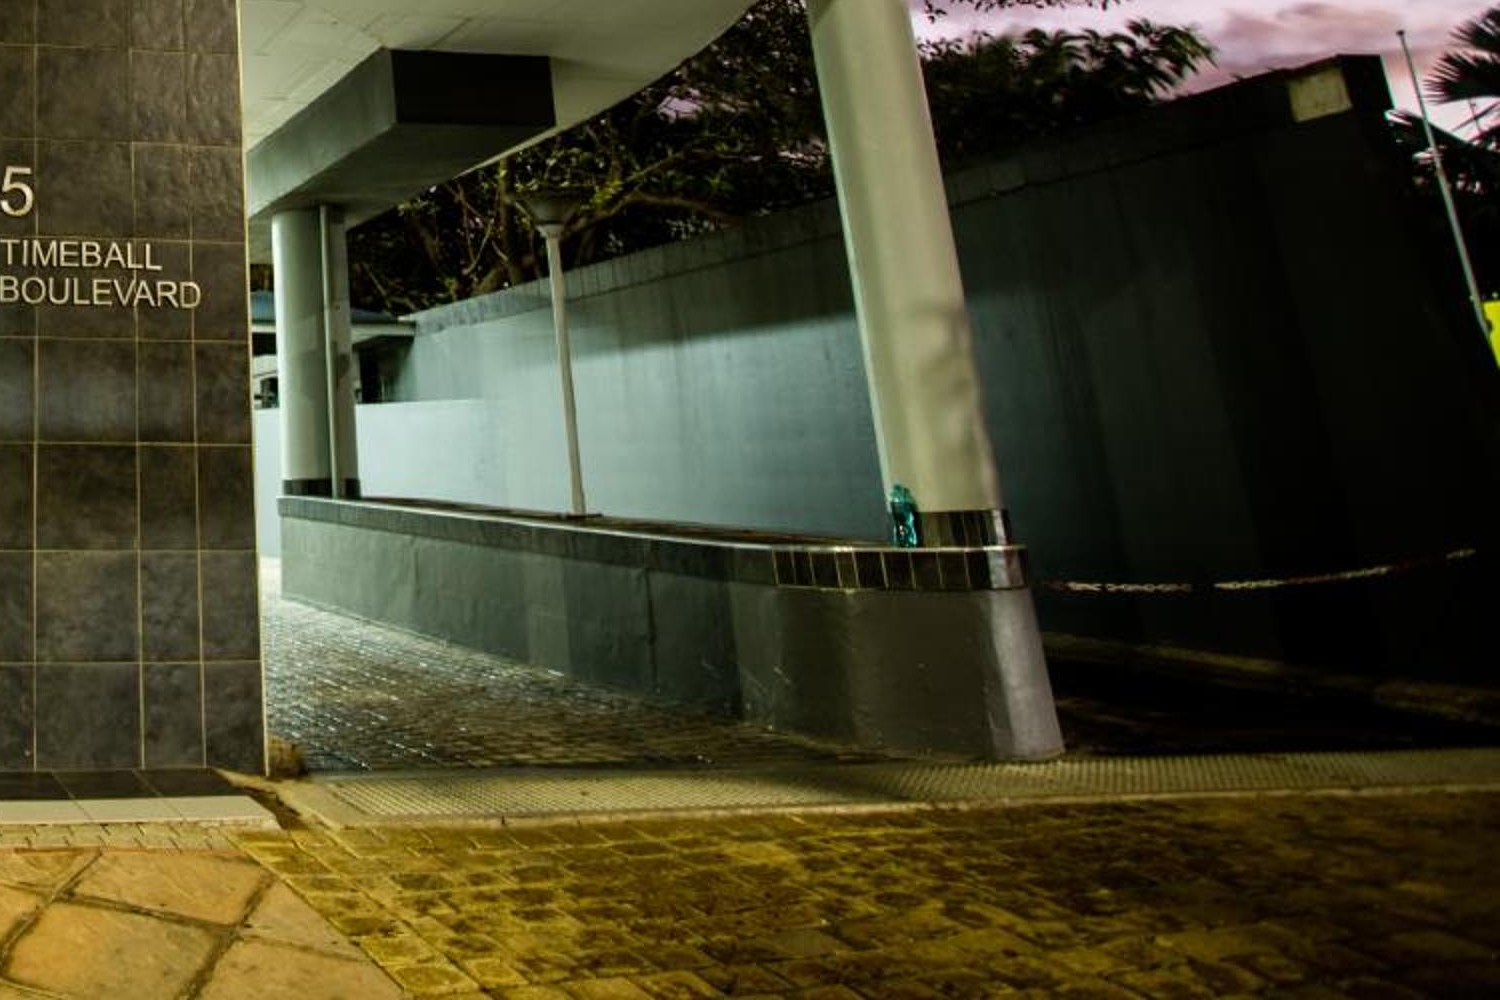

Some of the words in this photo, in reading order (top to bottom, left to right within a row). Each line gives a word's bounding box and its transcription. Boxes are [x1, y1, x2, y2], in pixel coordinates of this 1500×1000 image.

[0, 165, 35, 217] 5
[0, 238, 163, 272] TIMEBALL
[0, 275, 202, 309] BOULEVARD
